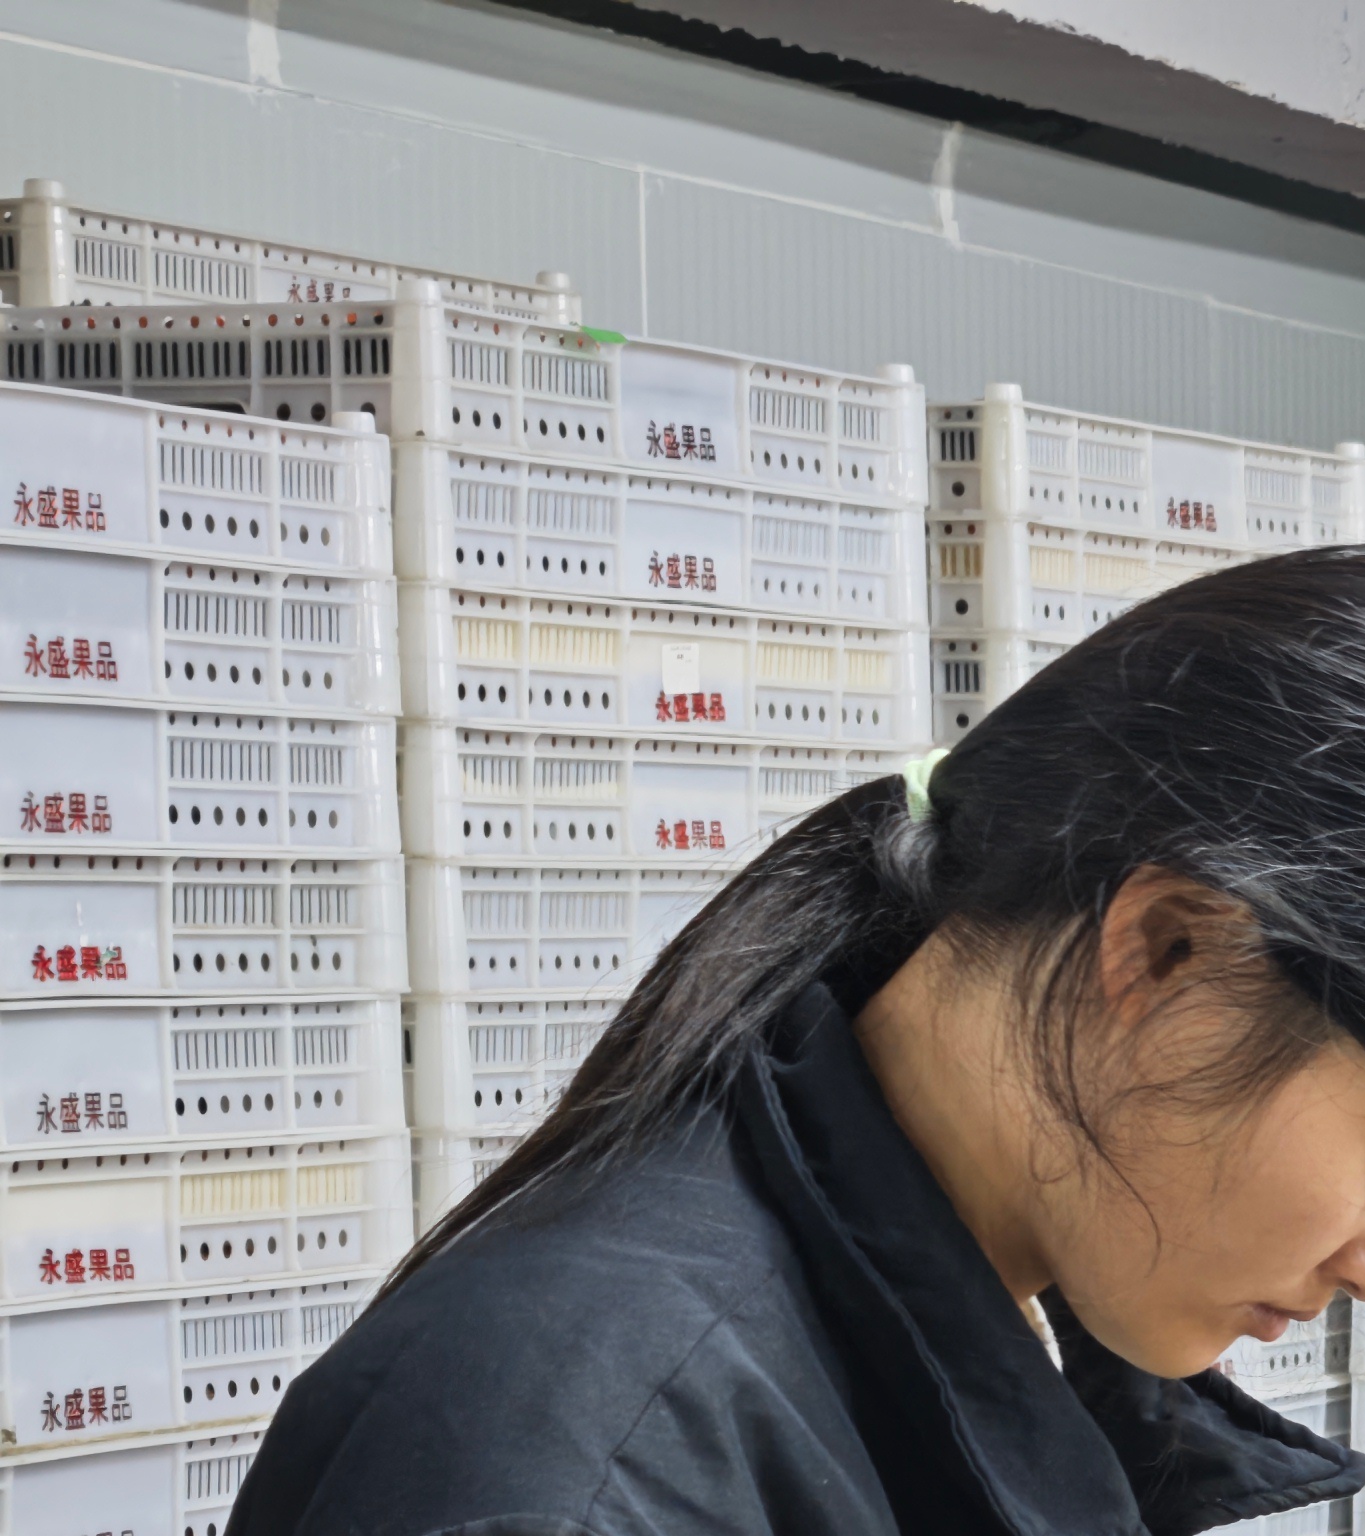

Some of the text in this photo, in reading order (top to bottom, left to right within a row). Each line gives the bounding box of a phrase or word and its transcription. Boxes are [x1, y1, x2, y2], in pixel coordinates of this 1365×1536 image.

[646, 419, 717, 462] 永盛果品
[14, 482, 106, 532] 永盛果品
[648, 549, 717, 592] 永盛果品
[24, 634, 118, 682] 永盛果品
[655, 690, 726, 722] 永盛果品
[20, 791, 112, 834] 永盛果品
[655, 818, 726, 850] 永盛果品
[32, 944, 128, 982] 永盛果品
[37, 1092, 128, 1134] 永盛果品
[39, 1248, 135, 1284] 永盛果品
[41, 1385, 133, 1432] 永盛果品
